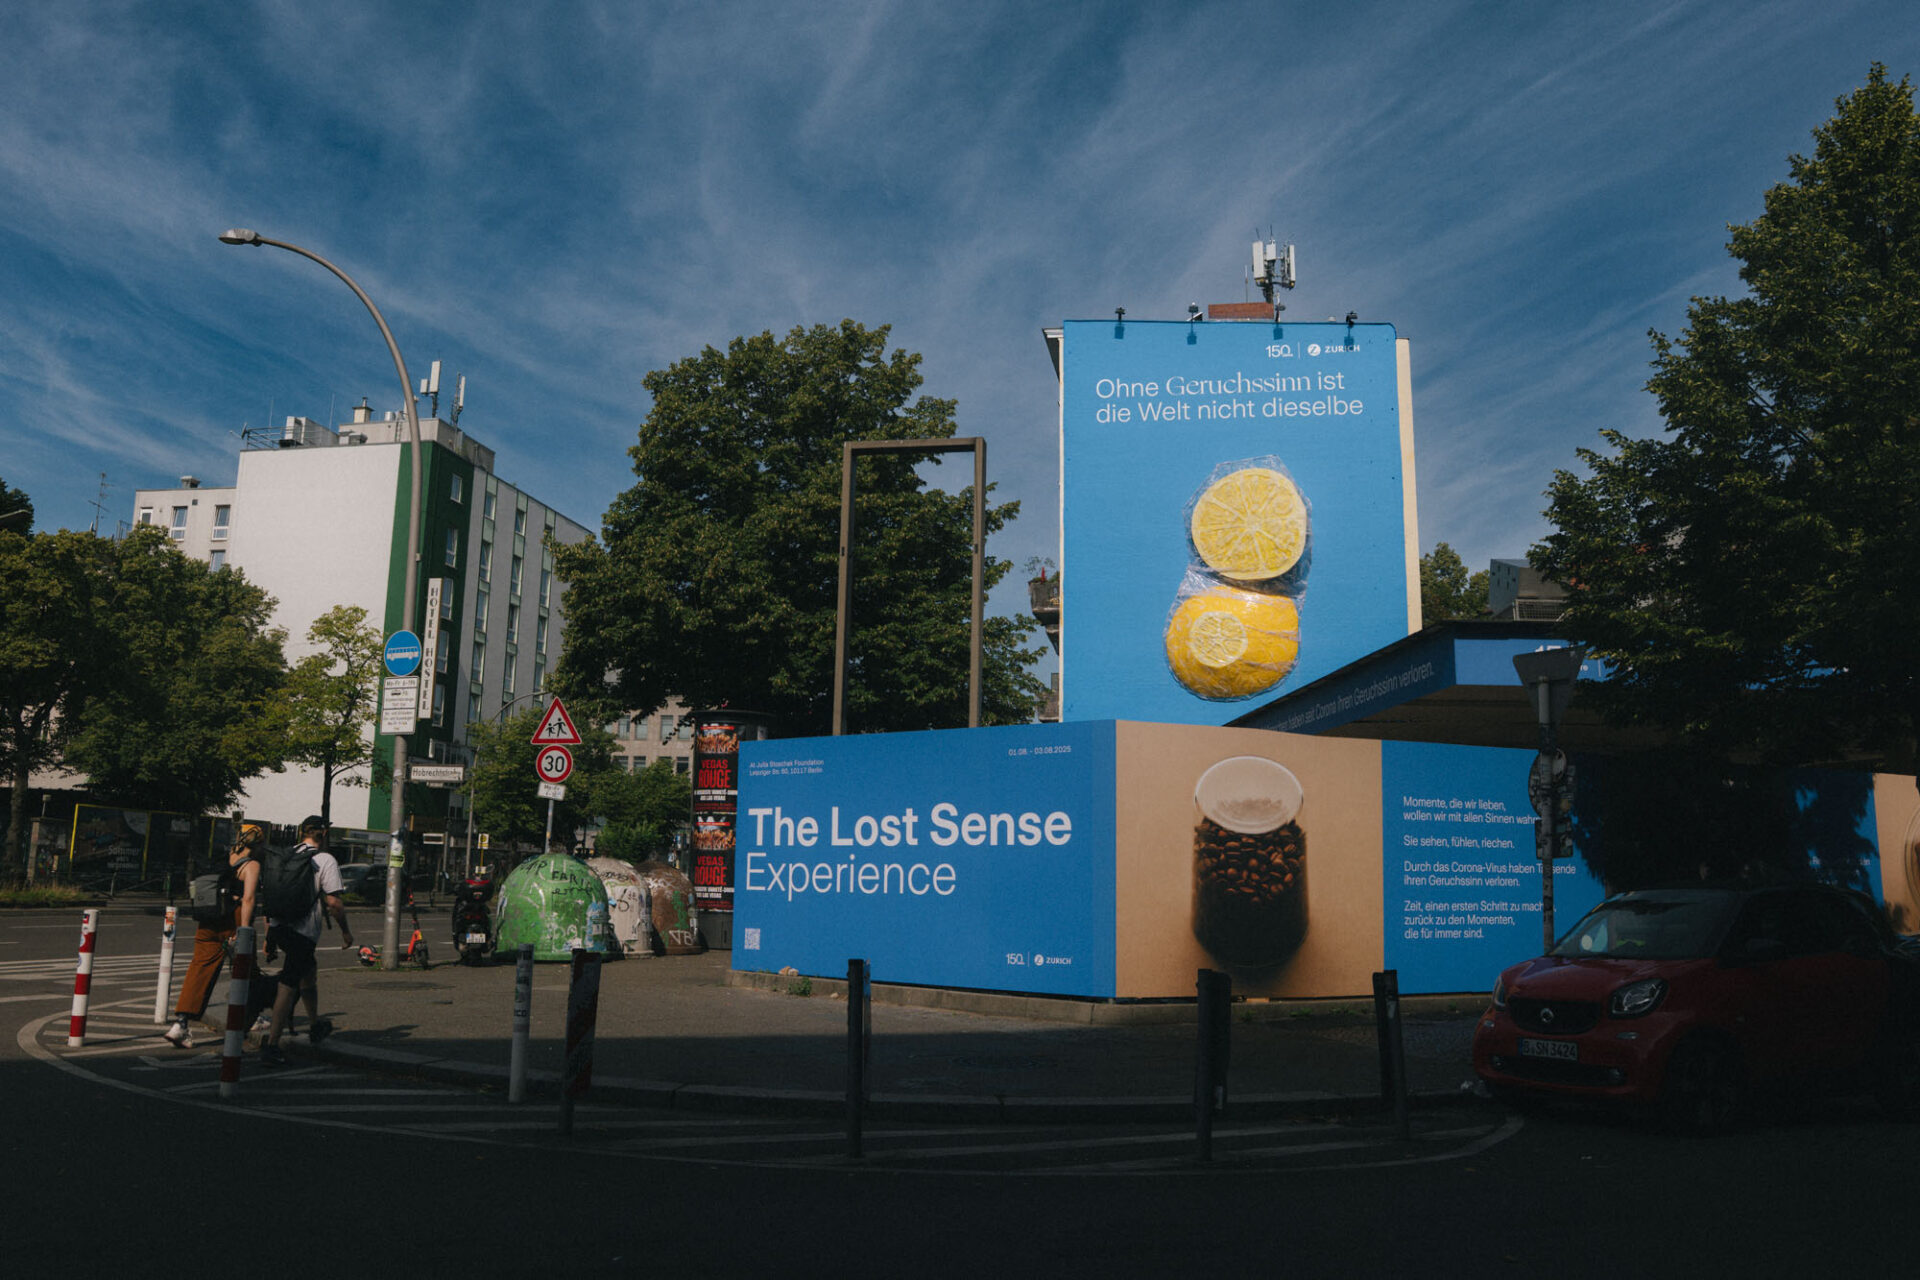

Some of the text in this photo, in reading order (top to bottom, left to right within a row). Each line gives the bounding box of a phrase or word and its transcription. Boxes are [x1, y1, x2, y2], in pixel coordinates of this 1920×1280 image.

[1325, 344, 1360, 354] ZURICH
[1096, 371, 1345, 399] Ohne Geruchssinn ist
[1096, 395, 1363, 424] die Welt nicht dieselbe
[427, 587, 439, 639] HOTEL
[421, 648, 433, 710] HOSTEL
[1354, 676, 1398, 707] Geruchssinn
[1398, 661, 1434, 688] verloren.
[544, 755, 565, 772] 30
[701, 759, 728, 768] VEGAS
[794, 759, 824, 767] Foundation
[698, 769, 732, 788] ROUGE
[1403, 795, 1506, 812] Momente, die wir lieben,
[1403, 810, 1432, 822] wollen
[1434, 811, 1447, 822] wir
[1448, 811, 1462, 822] mit
[1463, 811, 1483, 823] allen
[1485, 811, 1515, 824] Sinnen
[748, 803, 1072, 847] The Lost Sense
[1403, 835, 1515, 849] Sie sehen, fühlen, riechen.
[697, 855, 724, 866] VEGAS
[1404, 860, 1576, 875] Durch das Corona-Virus haben Tsende
[745, 852, 957, 902] Experience
[1404, 875, 1520, 887] ihren Geruchssinn verloren.
[1404, 900, 1423, 912] Zeit,
[1425, 901, 1449, 911] einen
[1451, 901, 1478, 911] ersten
[1480, 900, 1508, 911] Schritt
[1510, 902, 1520, 911] zu
[1404, 914, 1515, 927] zurück zu den Momenten,
[1404, 927, 1485, 939] die für immer sind.
[1045, 956, 1072, 965] ZURICH
[1550, 1043, 1577, 1058] 3424
